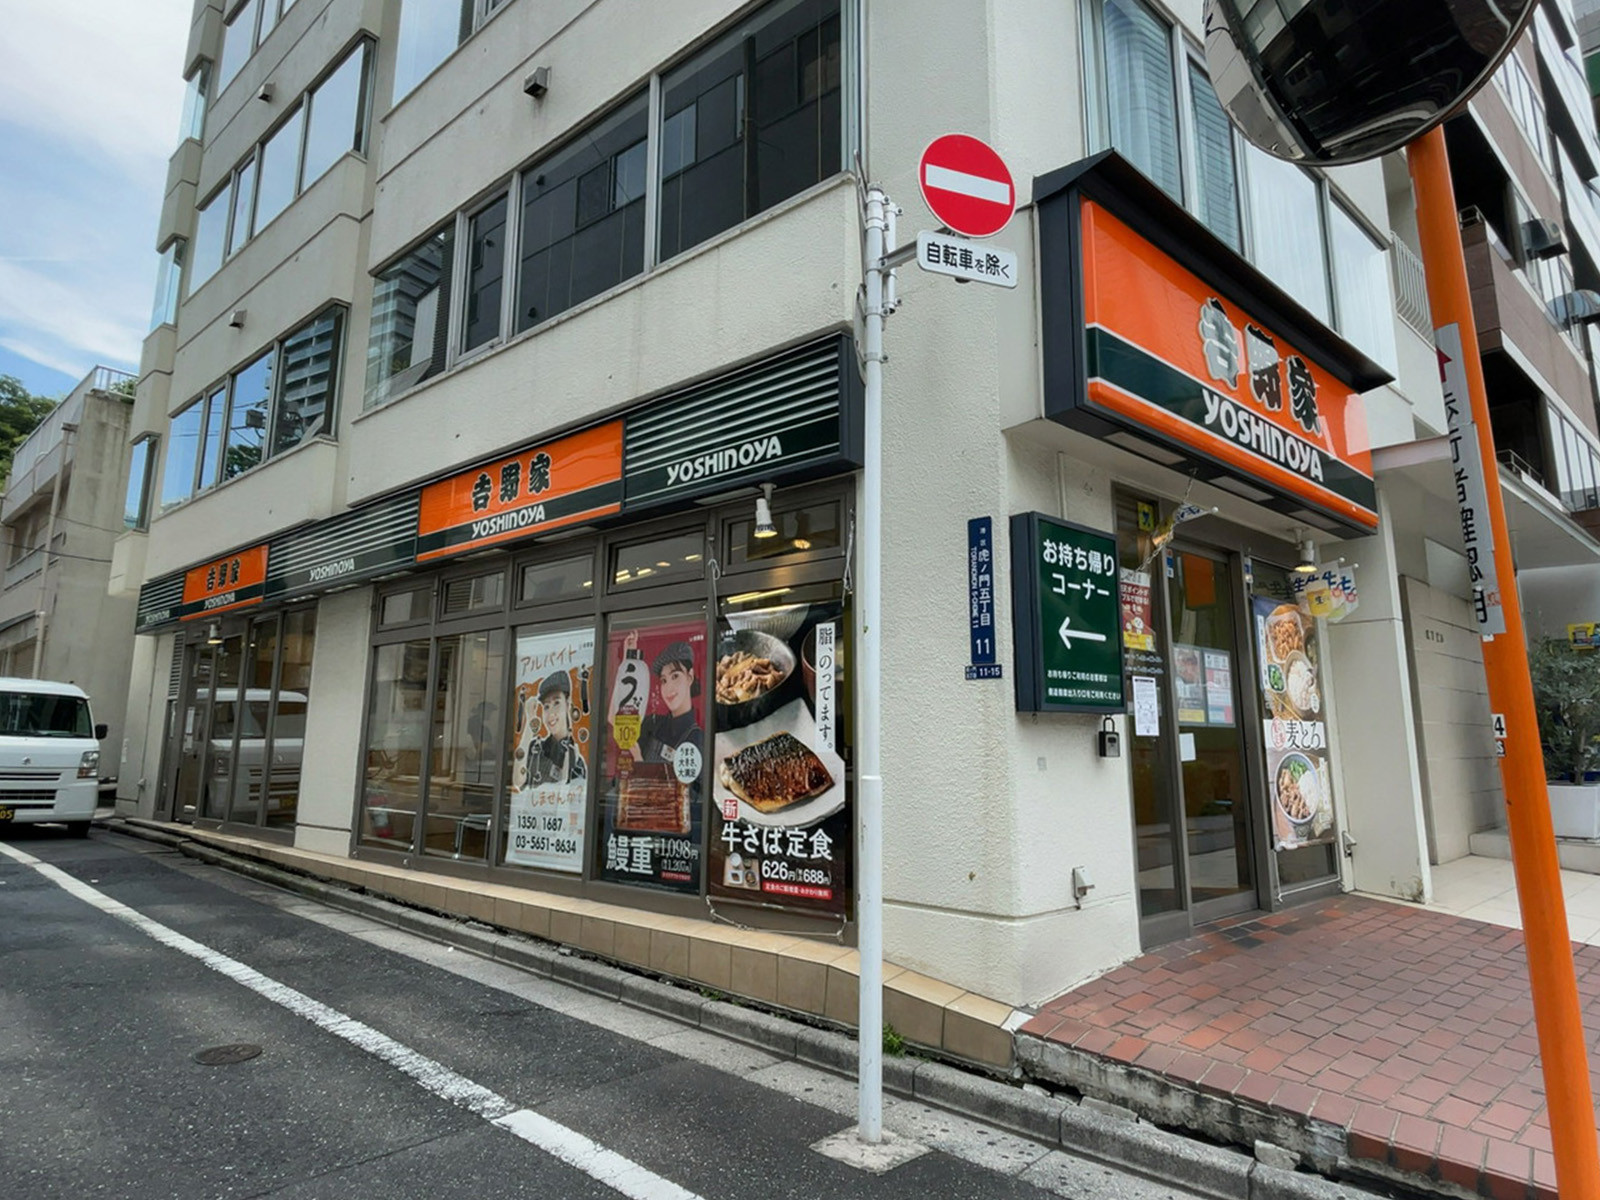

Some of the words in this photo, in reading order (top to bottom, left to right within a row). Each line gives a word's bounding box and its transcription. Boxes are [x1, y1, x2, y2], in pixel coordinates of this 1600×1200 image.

[927, 241, 1010, 279] 自転車を除く
[1199, 297, 1322, 435] 吉野家
[1202, 388, 1324, 482] YOSHINOYA
[667, 435, 782, 486] YOSHINOYA
[471, 452, 552, 512] 吉野家
[471, 504, 545, 539] YOSHINOYA
[206, 557, 242, 592] 吉野家
[309, 557, 355, 581] YOSHINOYA
[1042, 538, 1115, 577] お持ち帰り
[204, 591, 236, 610] YOSHINOYA
[978, 549, 991, 626] 虎ノ門五丁目
[1051, 572, 1110, 600] コーナー
[520, 645, 577, 676] アルバイト
[976, 638, 990, 655] 11
[818, 627, 834, 750] 脂、のってます。
[979, 667, 1000, 677] 11-15
[1285, 719, 1321, 749] 麦とろ
[517, 815, 537, 830] 1350
[542, 817, 563, 831] 1687
[723, 801, 738, 818] 新
[516, 835, 577, 854] 03-5651-8634
[606, 833, 654, 875] 鰻重
[660, 838, 698, 860] 1,098円
[721, 822, 833, 861] 牛さば定食
